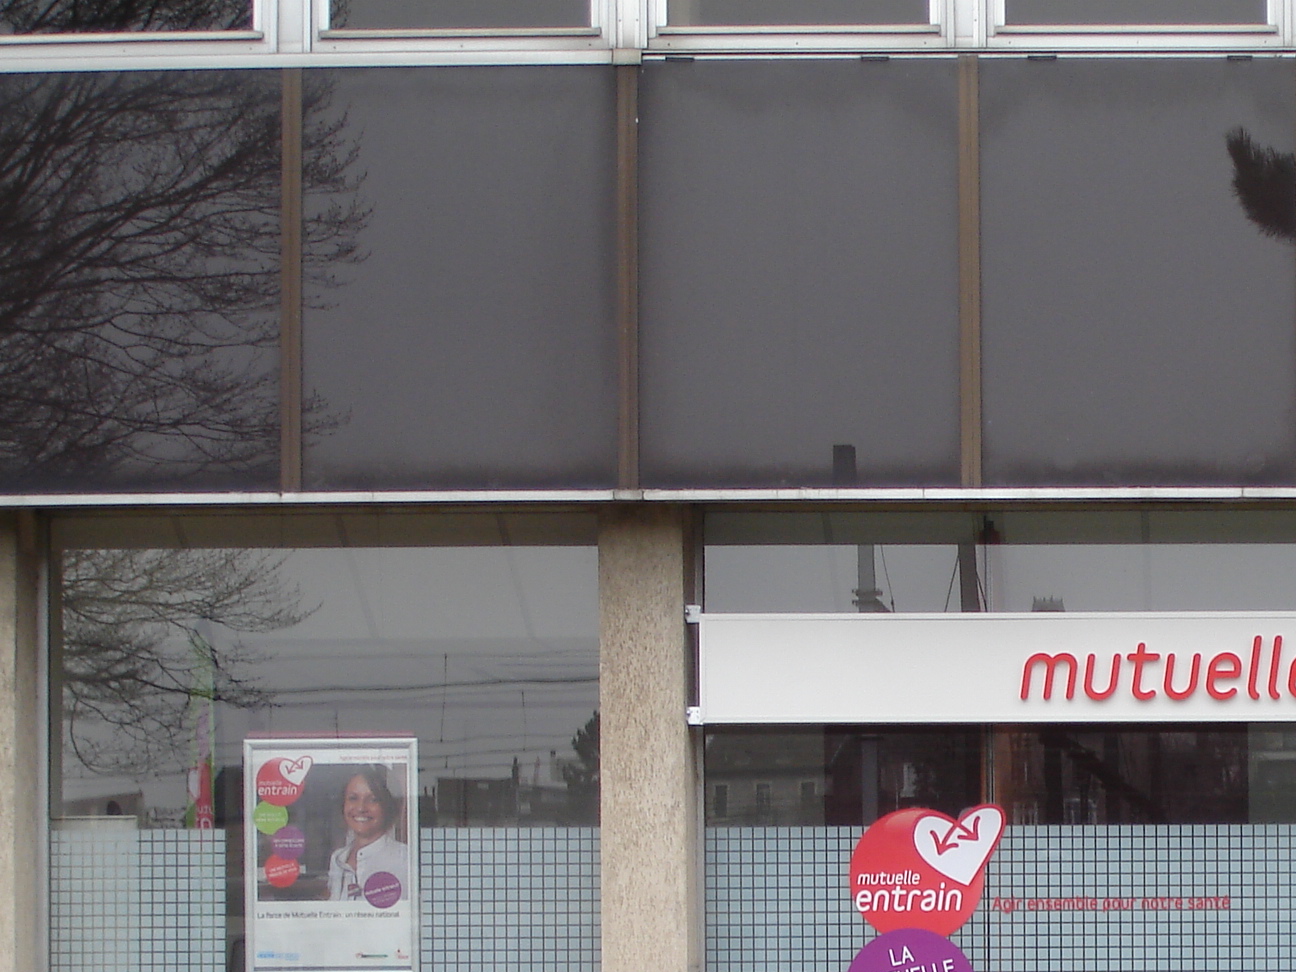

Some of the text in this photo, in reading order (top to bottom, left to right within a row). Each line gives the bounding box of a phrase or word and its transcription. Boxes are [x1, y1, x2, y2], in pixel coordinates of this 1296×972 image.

[257, 783, 298, 796] entrain
[857, 869, 921, 886] mutuelle
[855, 882, 963, 913] entrain
[992, 894, 1230, 914] Agir ensemble pour notre santé
[888, 945, 915, 967] LA
